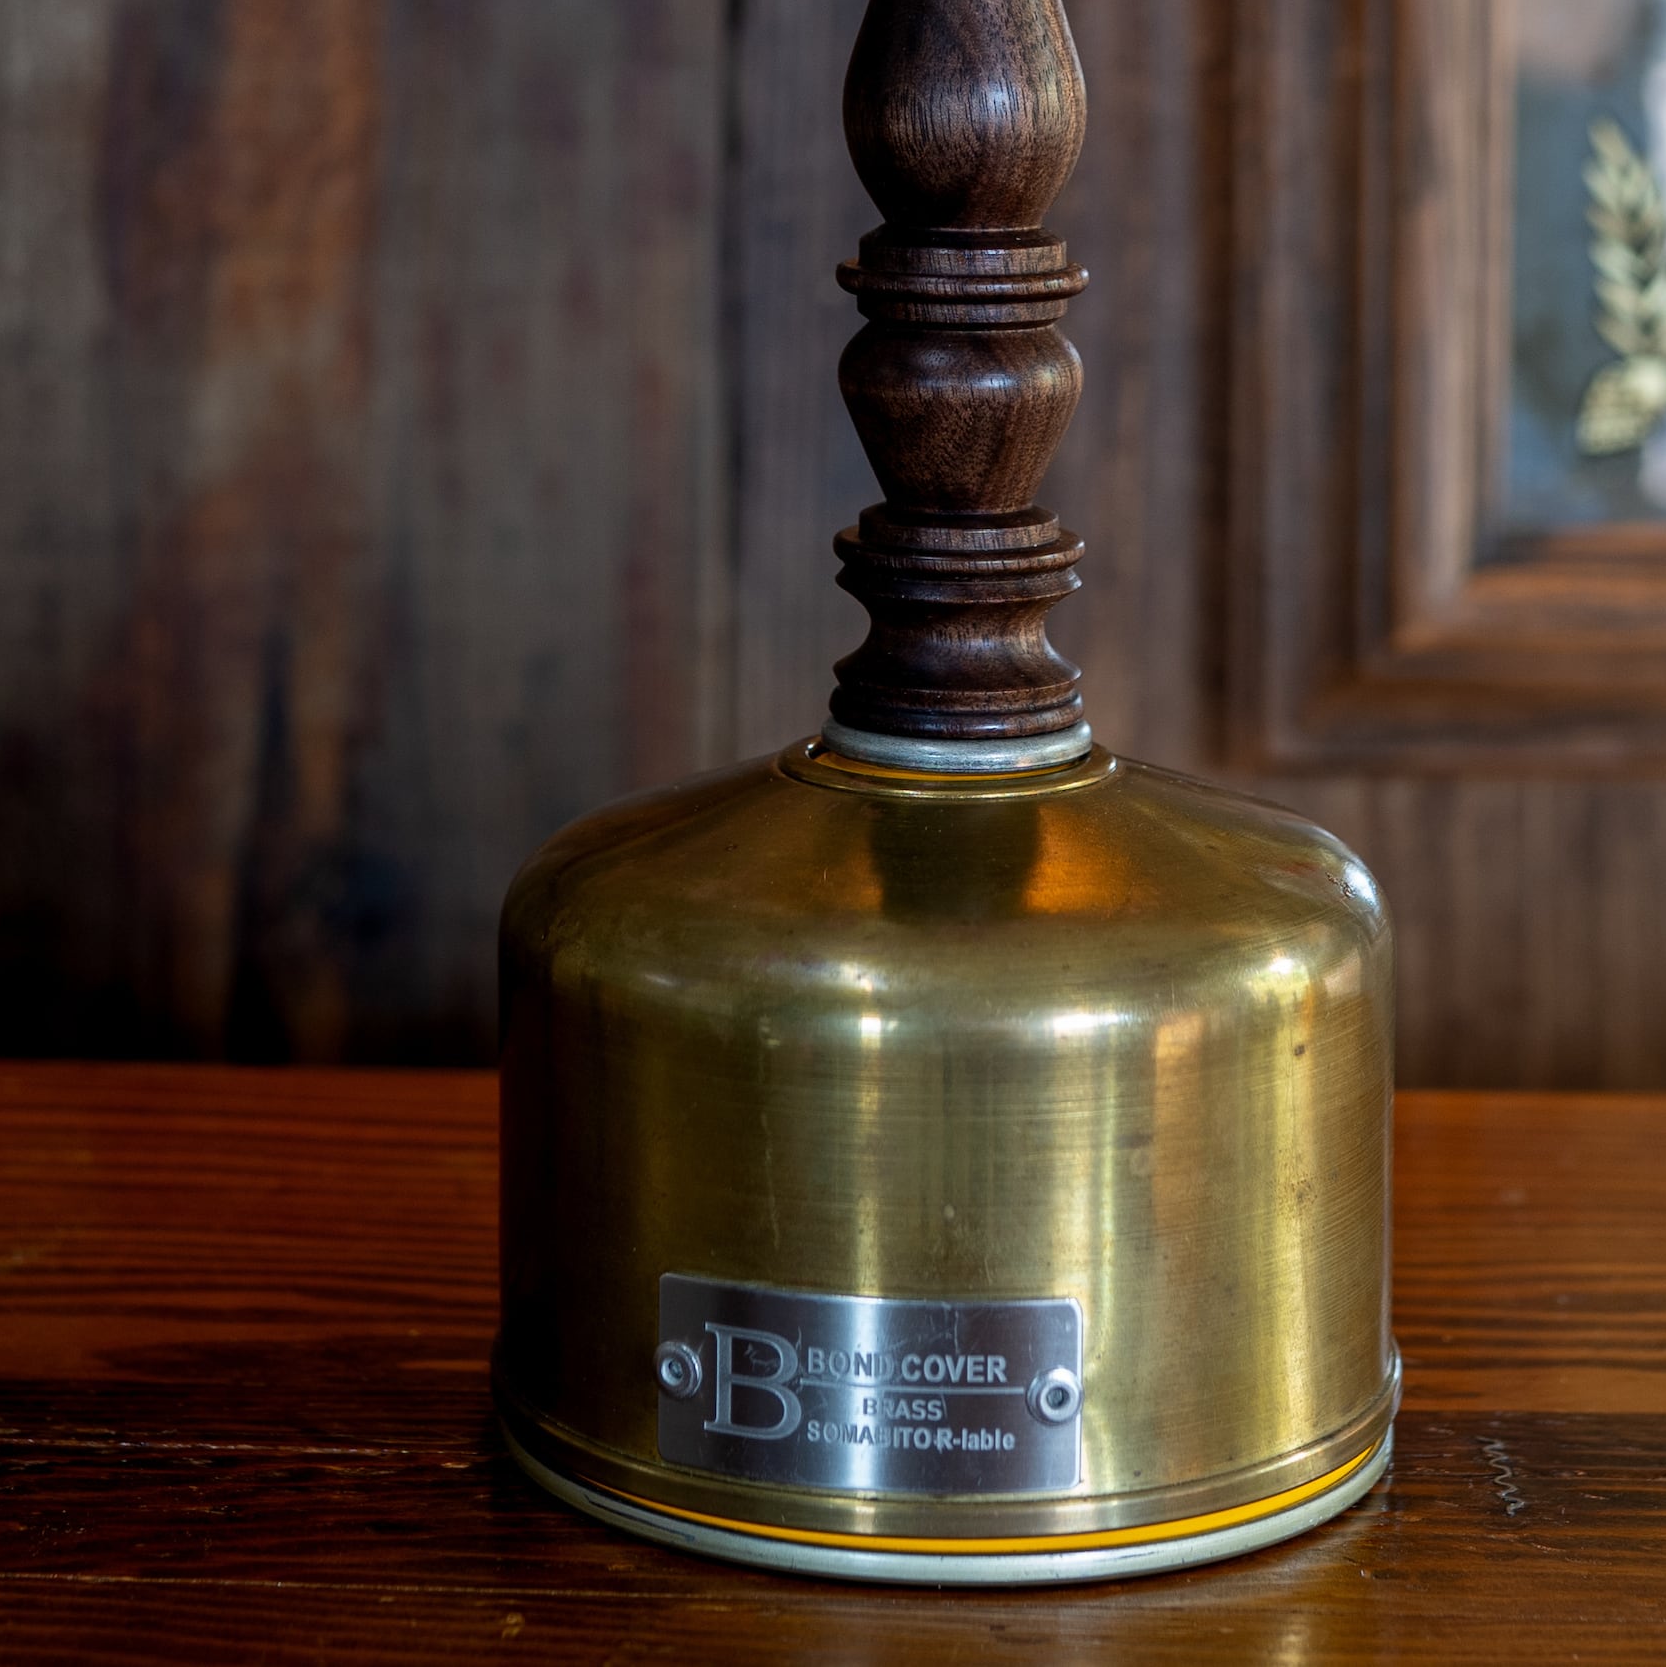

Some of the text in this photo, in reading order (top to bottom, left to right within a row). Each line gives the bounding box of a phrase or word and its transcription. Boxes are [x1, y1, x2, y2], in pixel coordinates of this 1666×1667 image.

[704, 1322, 802, 1439] B
[807, 1347, 1008, 1384] BOND COVER
[862, 1397, 943, 1421] BRASS
